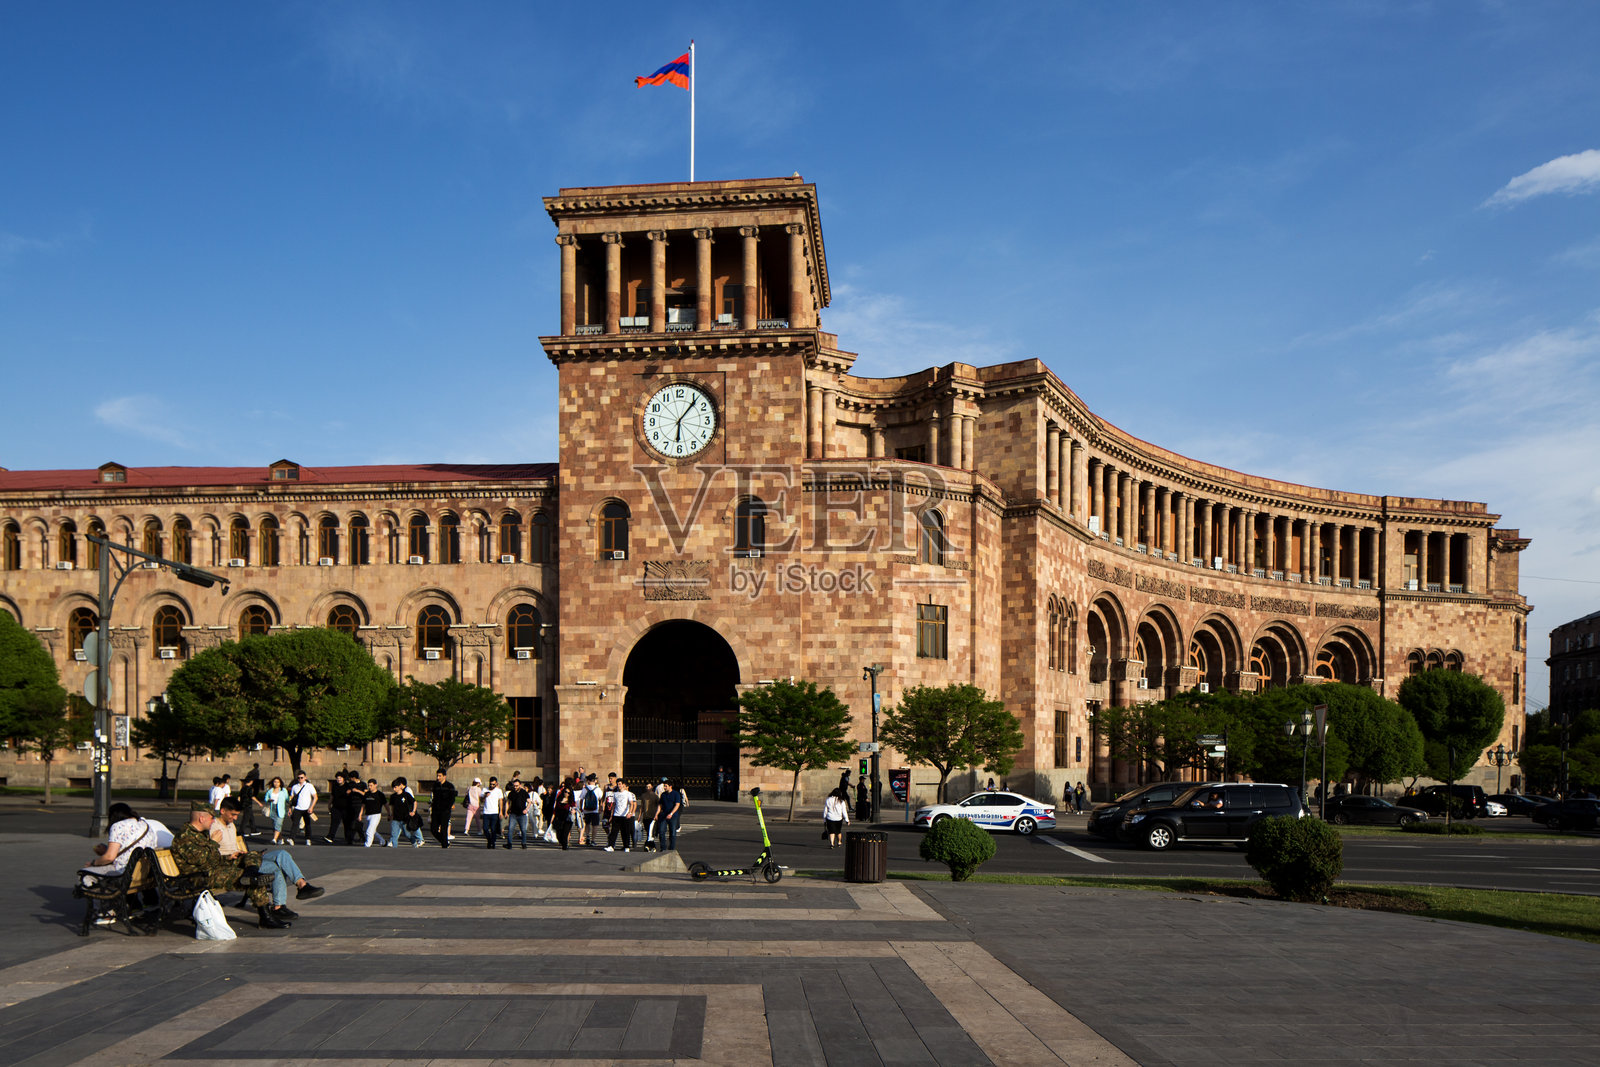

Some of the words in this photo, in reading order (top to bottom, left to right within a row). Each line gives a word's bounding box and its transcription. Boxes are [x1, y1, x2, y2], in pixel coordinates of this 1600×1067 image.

[662, 393, 670, 402] 11
[675, 388, 685, 399] 12
[652, 403, 661, 413] 10
[700, 402, 707, 412] 2
[649, 417, 656, 426] 9
[704, 416, 711, 425] 3
[653, 431, 659, 440] 8
[700, 430, 707, 439] 4
[663, 441, 669, 450] 7
[676, 445, 683, 454] 6
[690, 441, 697, 450] 5
